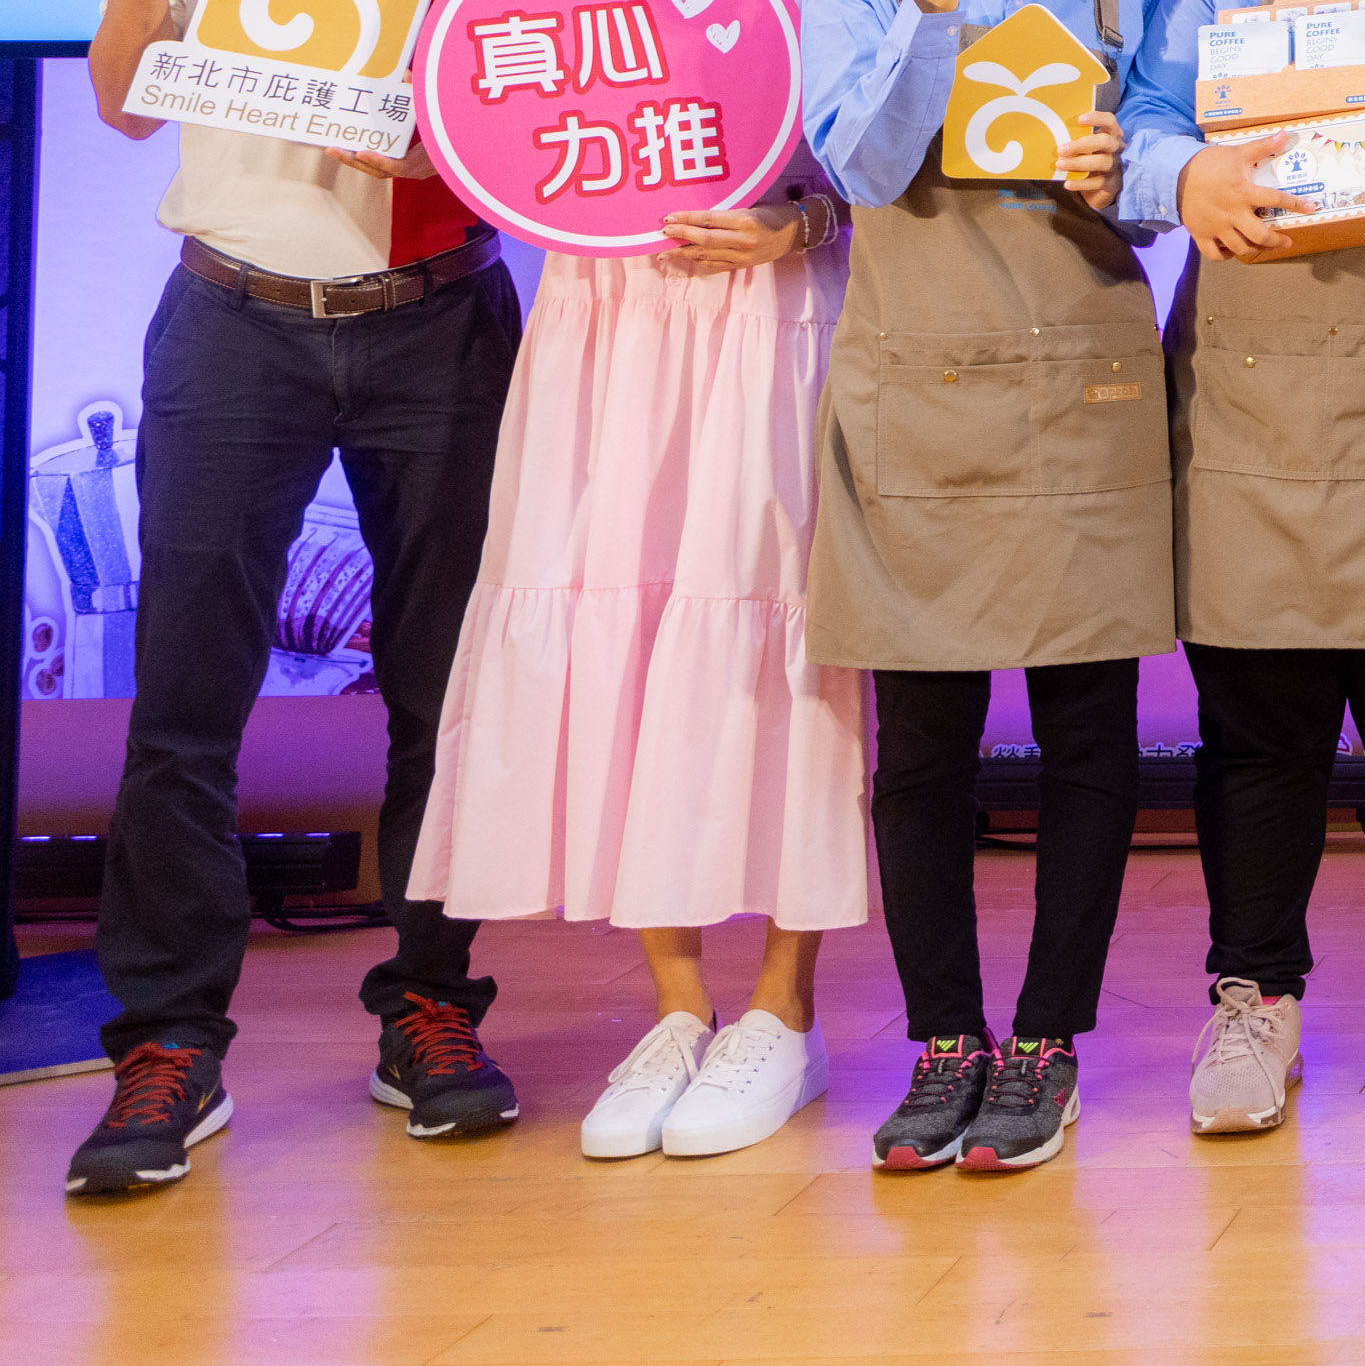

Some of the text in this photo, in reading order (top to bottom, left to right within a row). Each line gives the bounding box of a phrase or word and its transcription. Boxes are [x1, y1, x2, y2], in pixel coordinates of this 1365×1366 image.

[1209, 31, 1237, 39] PURE
[1209, 37, 1246, 47] COFFEE
[1306, 21, 1332, 31] PURE
[1306, 27, 1341, 38] COFFEE
[472, 5, 665, 98] 真心
[149, 51, 412, 124] 新北市庇護工場
[140, 84, 402, 153] Smile Heart Energy
[537, 101, 724, 202] 力推
